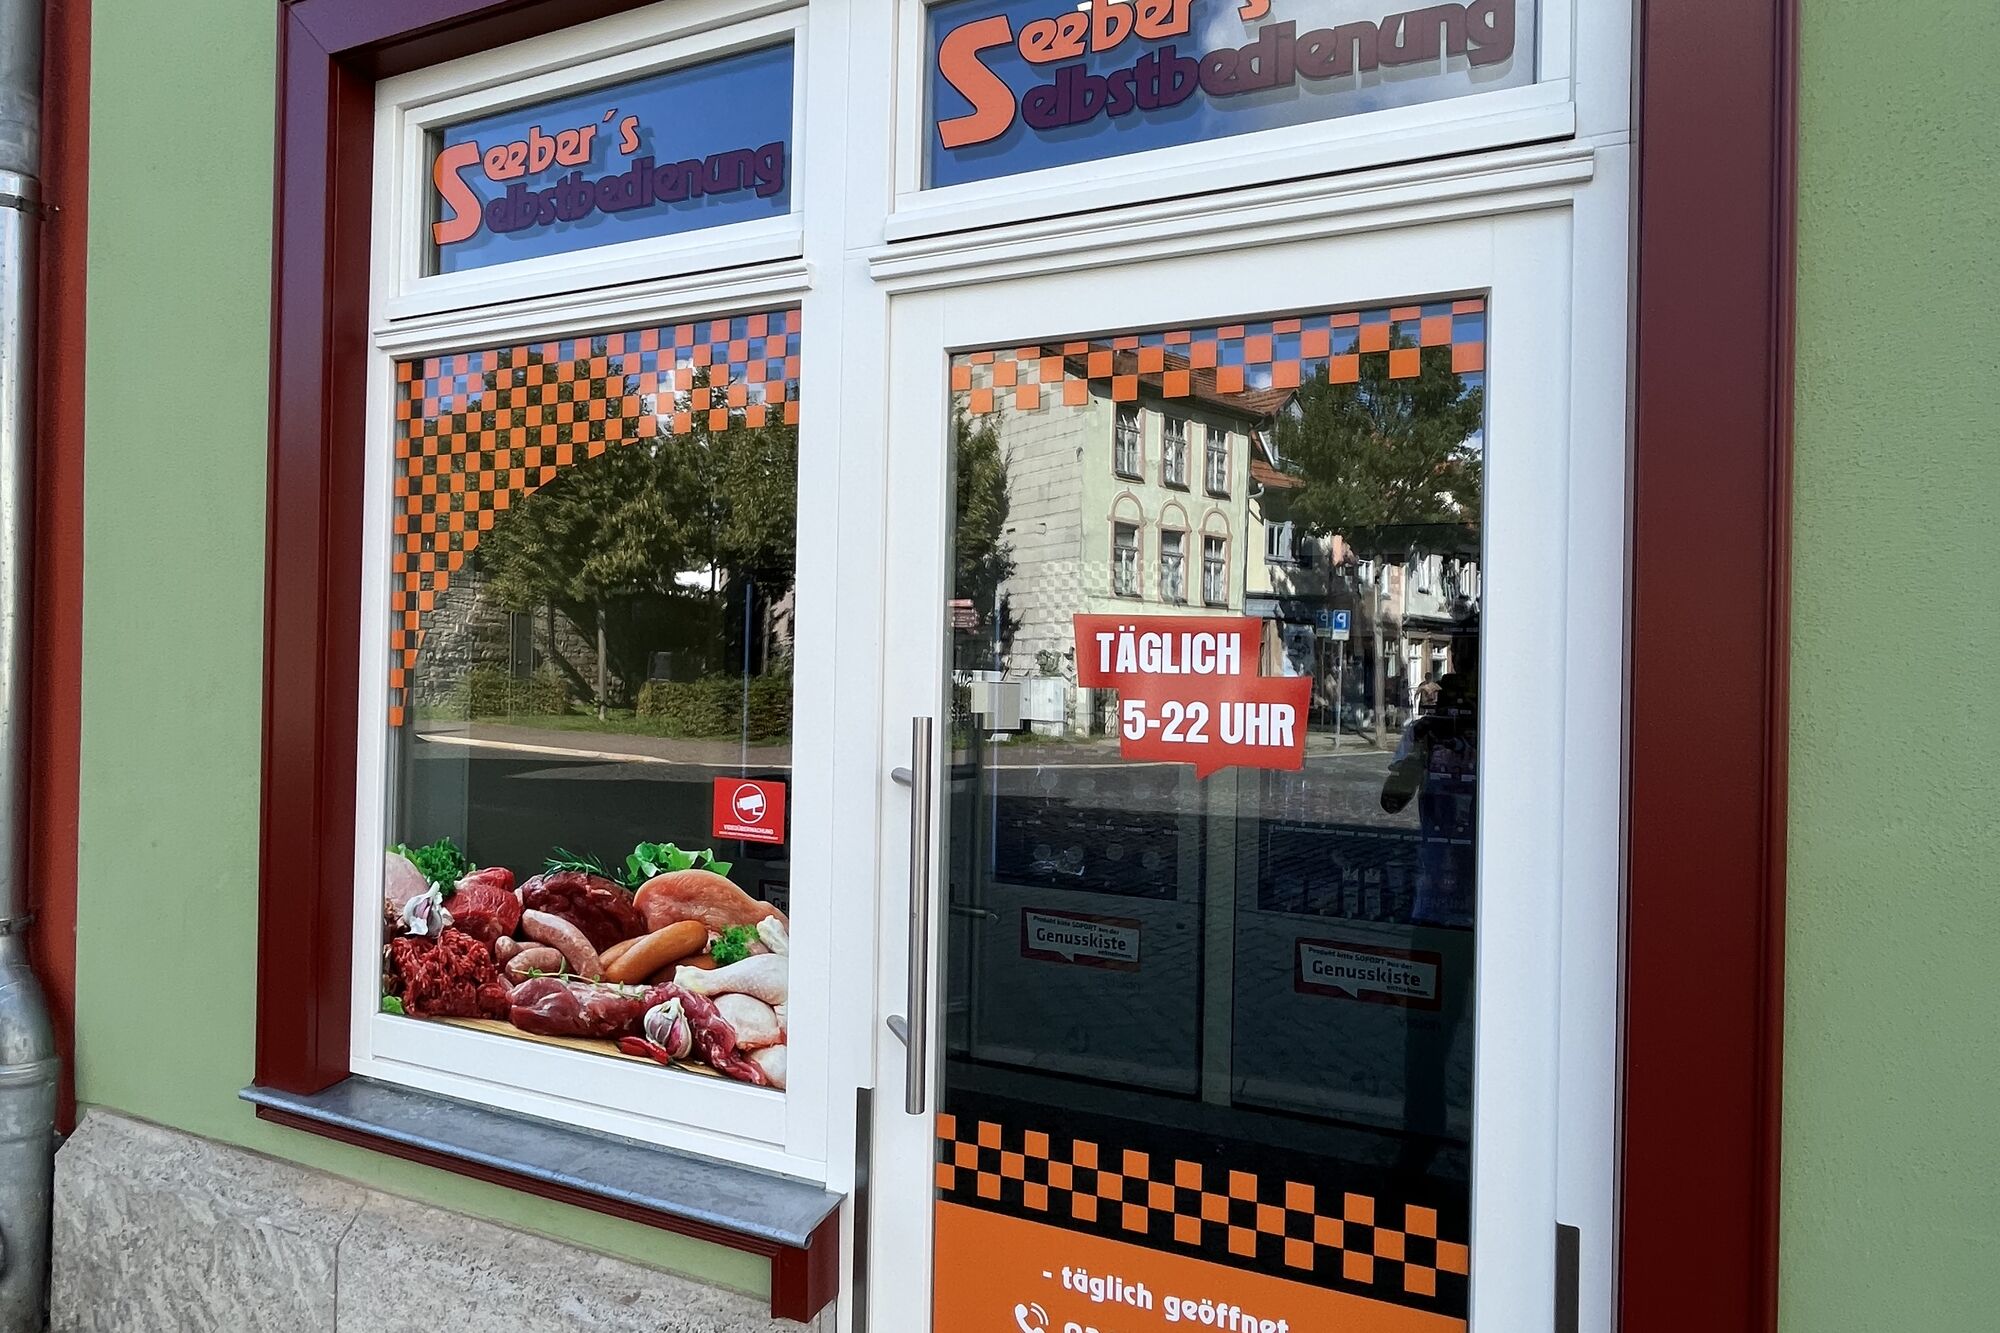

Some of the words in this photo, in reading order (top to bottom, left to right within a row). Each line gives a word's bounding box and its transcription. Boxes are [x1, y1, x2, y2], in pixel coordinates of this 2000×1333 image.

[1096, 625, 1241, 675] TÄGLICH
[1123, 699, 1209, 744] 5-22
[1219, 701, 1296, 747] UHR
[1036, 928, 1125, 950] Genusskiste
[1072, 921, 1097, 931] SOFORT
[1312, 959, 1421, 987] Genusskiste
[1355, 953, 1386, 965] SOFORT
[1061, 1266, 1153, 1310] täglich
[1163, 1295, 1289, 1333] geöffnet
